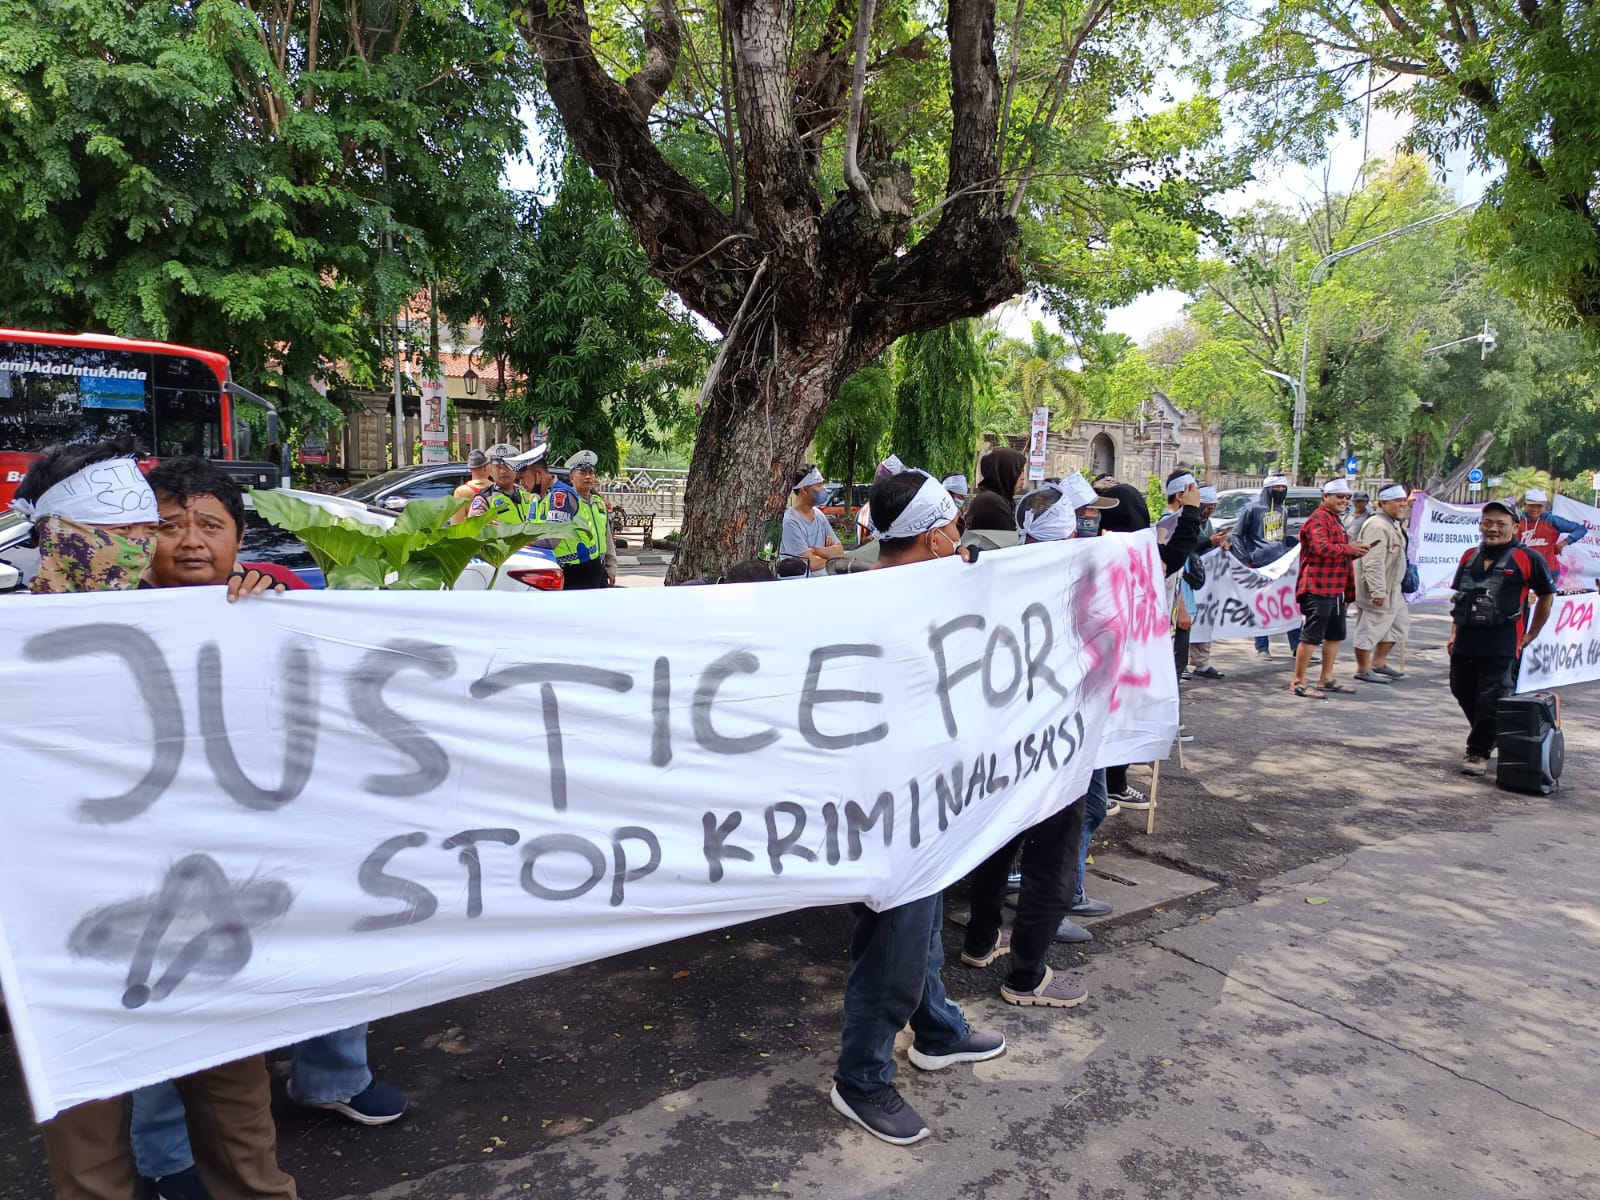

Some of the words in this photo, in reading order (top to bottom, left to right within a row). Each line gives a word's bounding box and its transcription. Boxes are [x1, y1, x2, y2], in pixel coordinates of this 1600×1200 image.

[1423, 532, 1444, 543] HARUS
[1445, 534, 1473, 544] BERANI
[1418, 556, 1438, 564] SESUAI
[1256, 586, 1302, 629] SOG
[1555, 601, 1593, 635] DOA
[1526, 641, 1583, 675] SEMOGA
[23, 622, 889, 823] JUSTICE
[928, 601, 1067, 738] FOR
[350, 827, 661, 932] STOP
[702, 711, 1085, 882] KRIMINALISASI
